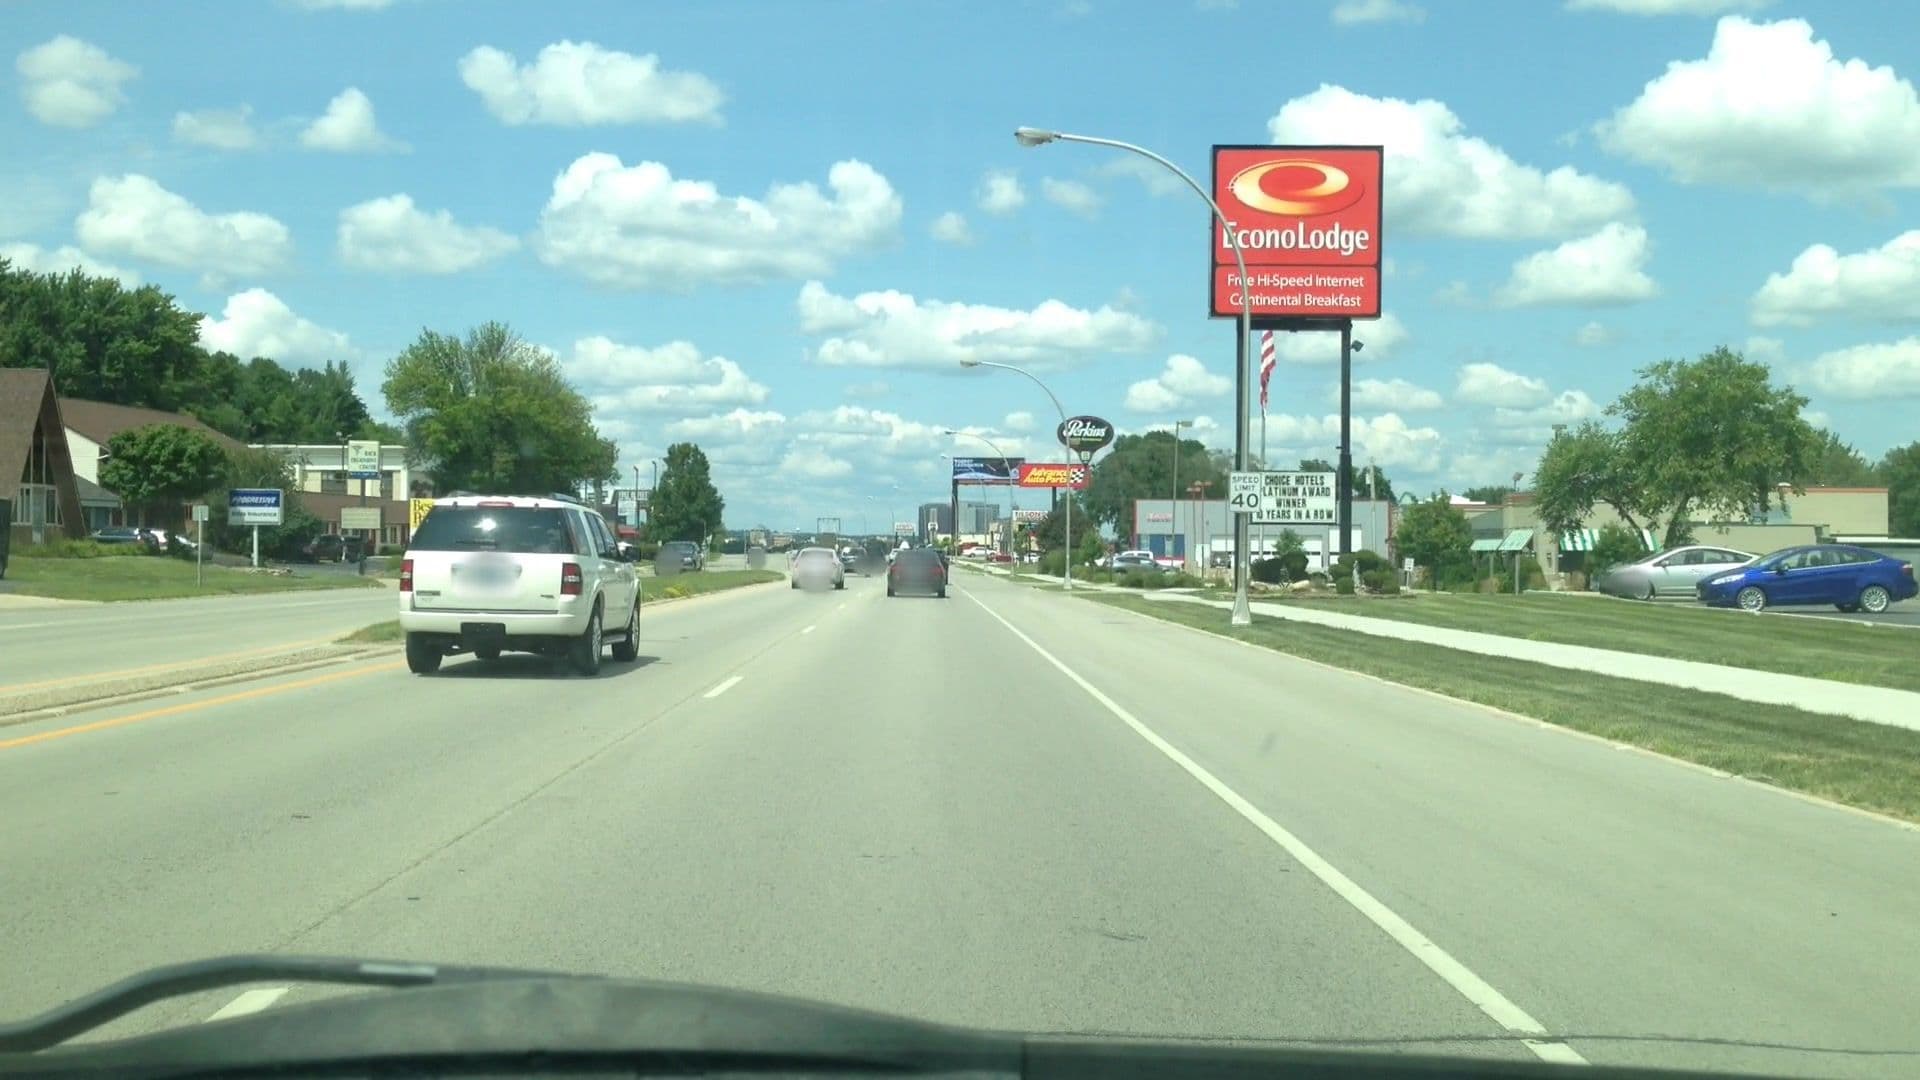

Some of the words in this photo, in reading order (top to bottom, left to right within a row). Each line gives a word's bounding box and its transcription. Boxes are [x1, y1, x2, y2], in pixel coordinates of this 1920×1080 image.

[1222, 222, 1369, 256] EconoLodge
[1257, 274, 1312, 289] Hi-Speed
[1316, 275, 1364, 287] Internet
[1229, 293, 1301, 306] Continental
[1304, 293, 1361, 307] Breakfast
[1062, 419, 1106, 437] Perkins
[1023, 474, 1045, 483] Auto
[1232, 476, 1259, 484] SPEED
[1264, 475, 1291, 486] CHOICE
[1295, 475, 1325, 486] HOTELS
[1262, 487, 1299, 497] LATINUM
[1301, 487, 1331, 497] AWARD
[1231, 493, 1259, 508] 40
[1275, 498, 1307, 508] WINNER
[1266, 509, 1291, 520] YEARS
[1294, 509, 1302, 520] IN
[1305, 509, 1311, 520] A
[1313, 509, 1334, 520] ROW
